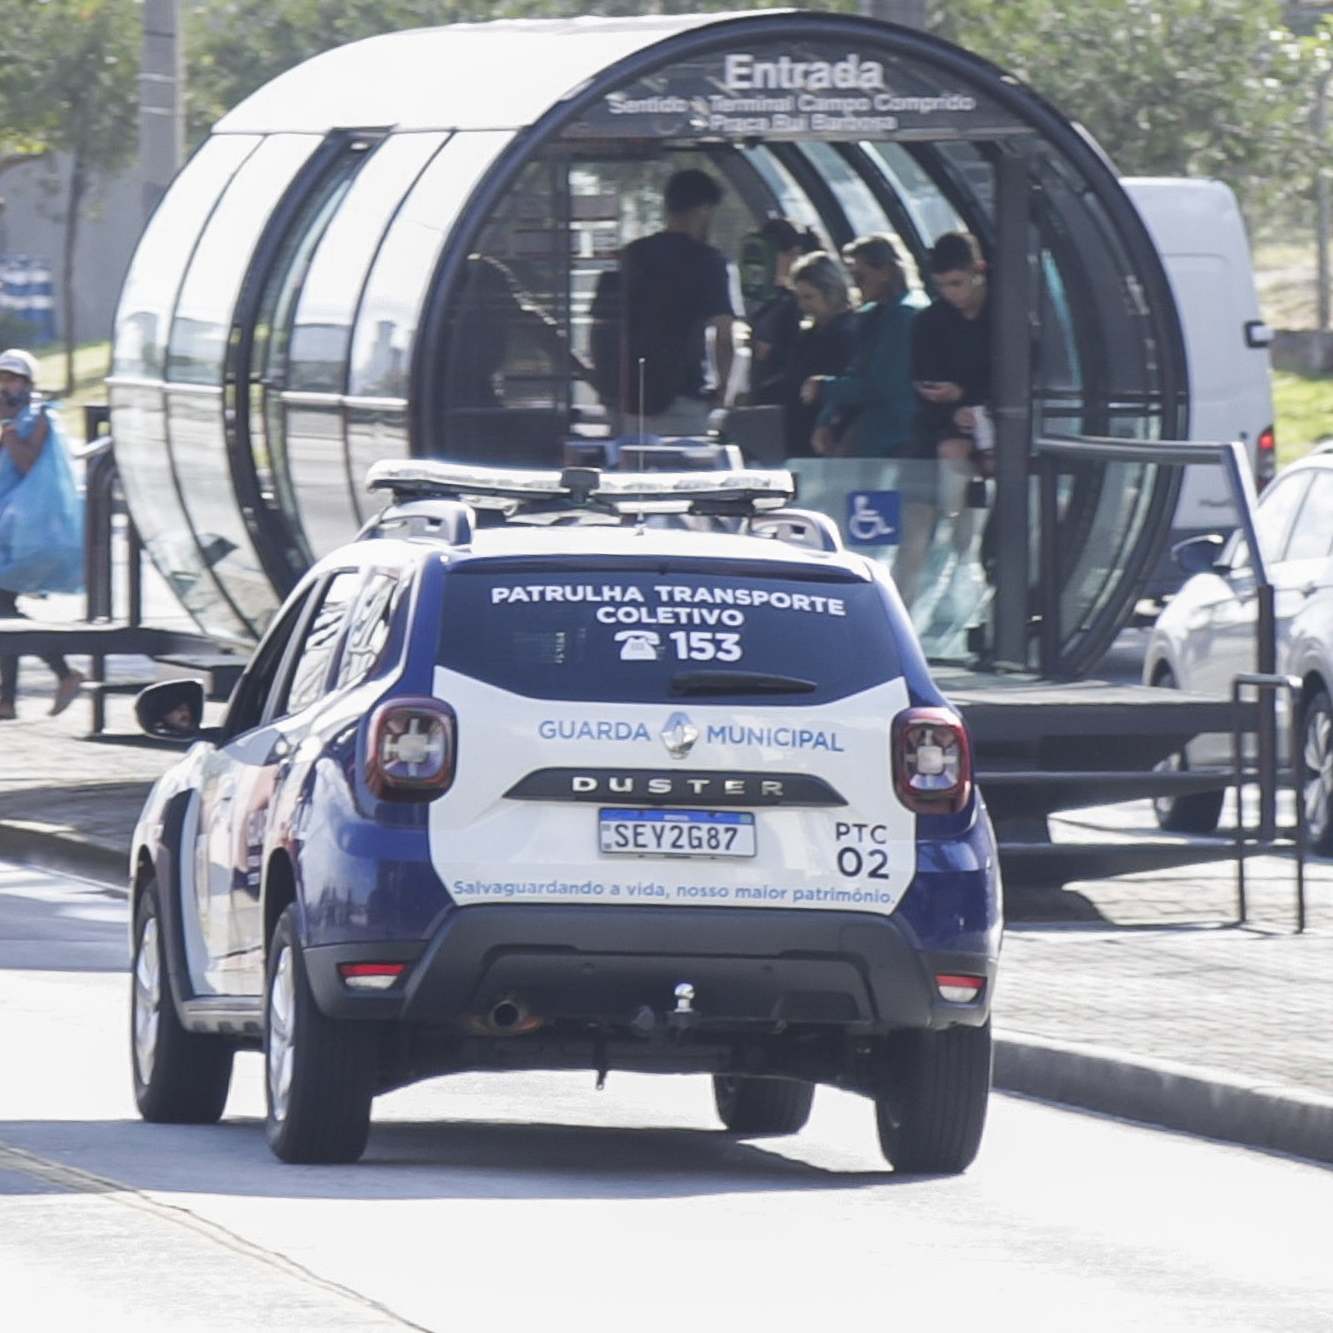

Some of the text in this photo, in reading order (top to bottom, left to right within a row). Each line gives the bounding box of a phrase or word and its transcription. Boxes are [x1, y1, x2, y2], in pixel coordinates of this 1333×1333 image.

[723, 53, 885, 90] Entrada
[608, 93, 977, 114] Sentido Terminal Campo Comprido
[771, 114, 810, 131] Rui
[810, 114, 899, 131] Barbosa
[491, 585, 846, 617] PATRULHA TRANSPORTE
[596, 606, 745, 627] COLETIVO
[669, 631, 743, 662] 153
[537, 719, 844, 752] GUARDA MUNICIPAL
[572, 775, 785, 796] DUSTER
[614, 823, 738, 851] SEY2G87
[835, 822, 887, 845] PTC
[836, 847, 890, 880] 02
[453, 880, 896, 905] Salvaguardando a vida, nosso maior patrimônio.
